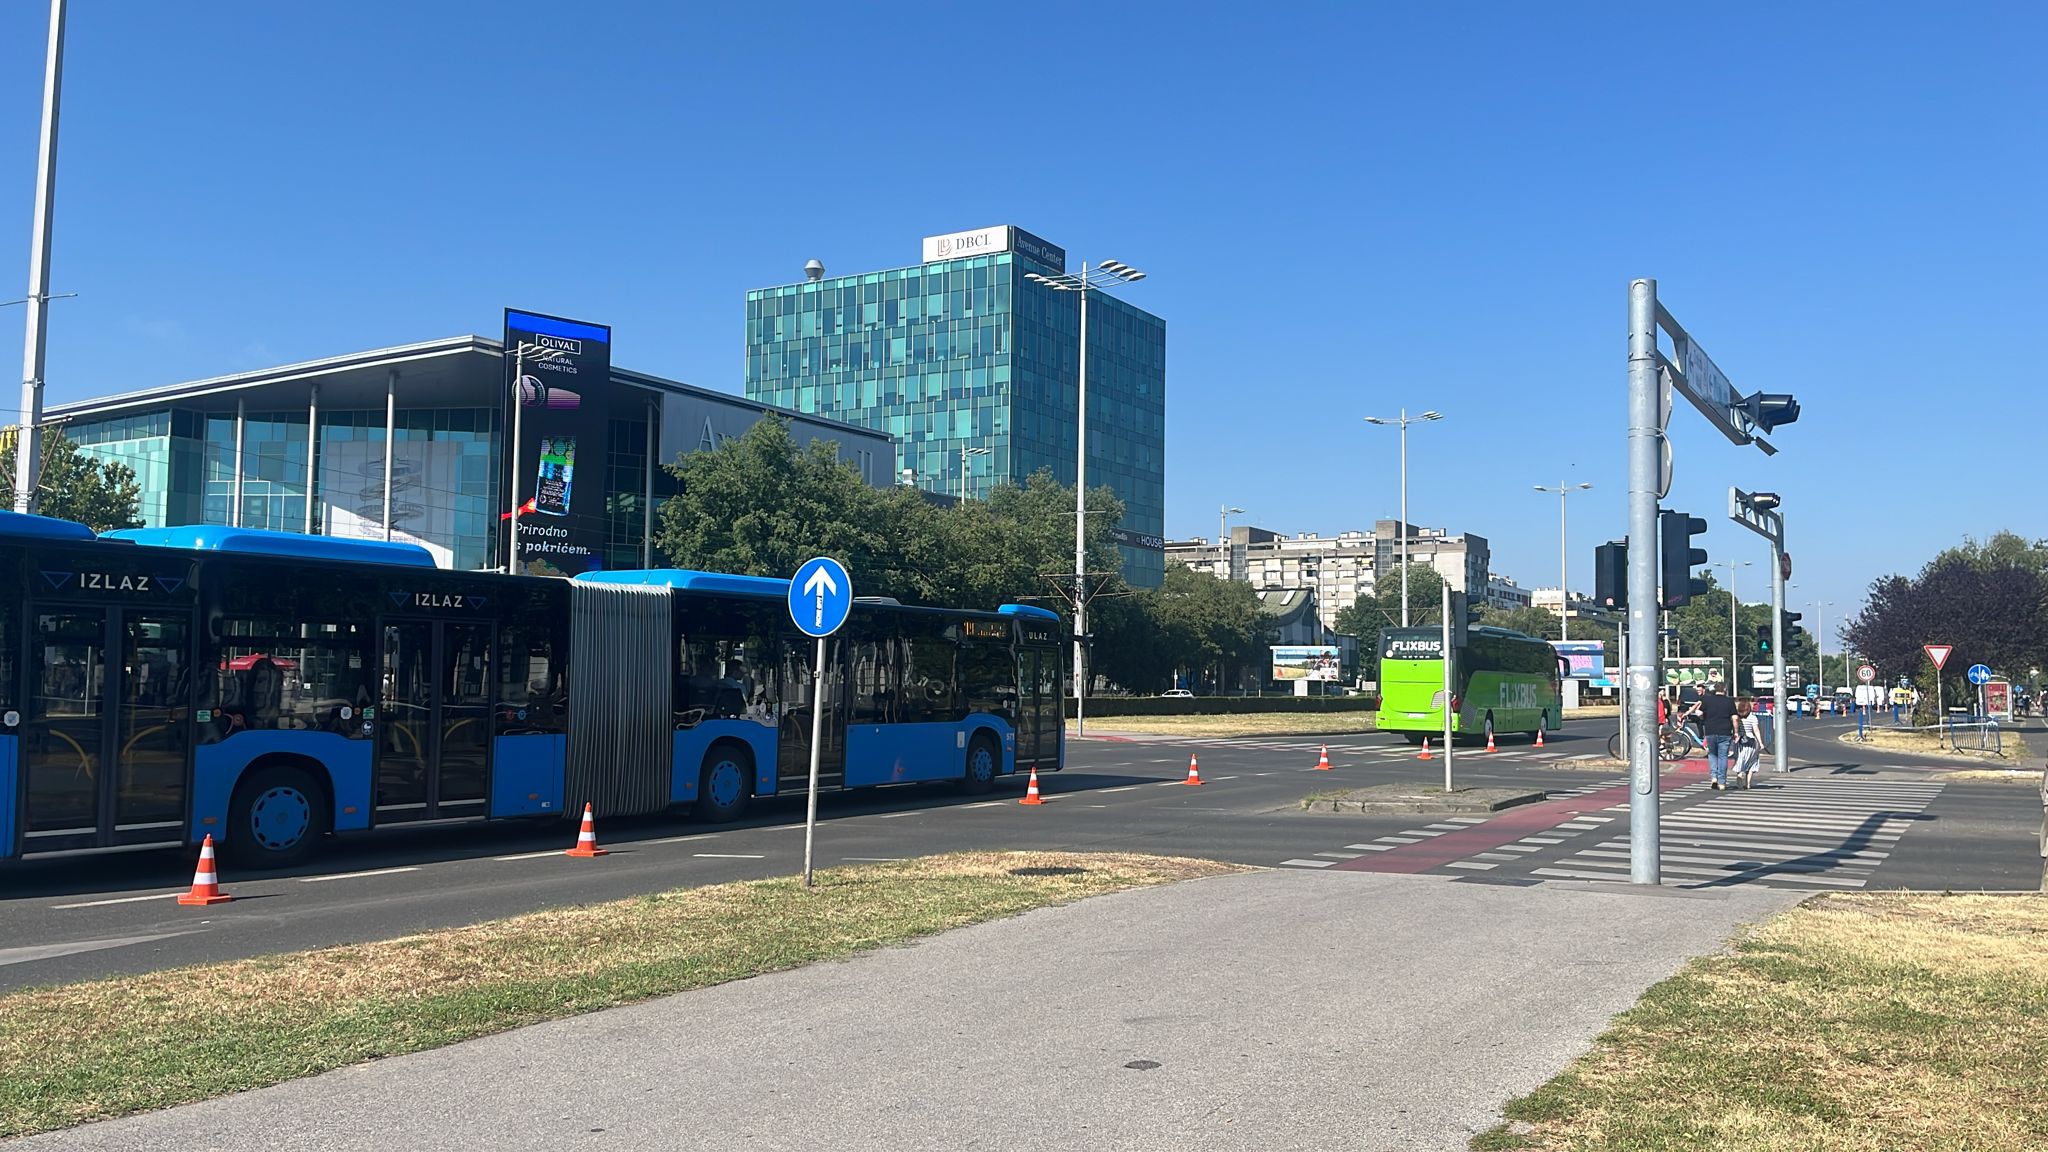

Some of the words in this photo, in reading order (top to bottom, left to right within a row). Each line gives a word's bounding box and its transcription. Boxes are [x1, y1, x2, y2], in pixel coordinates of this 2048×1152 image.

[1017, 235, 1040, 256] Avenue
[1041, 246, 1062, 267] Center
[541, 337, 576, 351] OLIVAL
[538, 362, 578, 374] COSMETICS
[525, 541, 591, 555] pokrićem.
[80, 573, 149, 591] IZLAZ
[415, 593, 463, 608] IZLAZ
[1028, 631, 1048, 641] ULAZ
[1861, 669, 1872, 677] 60
